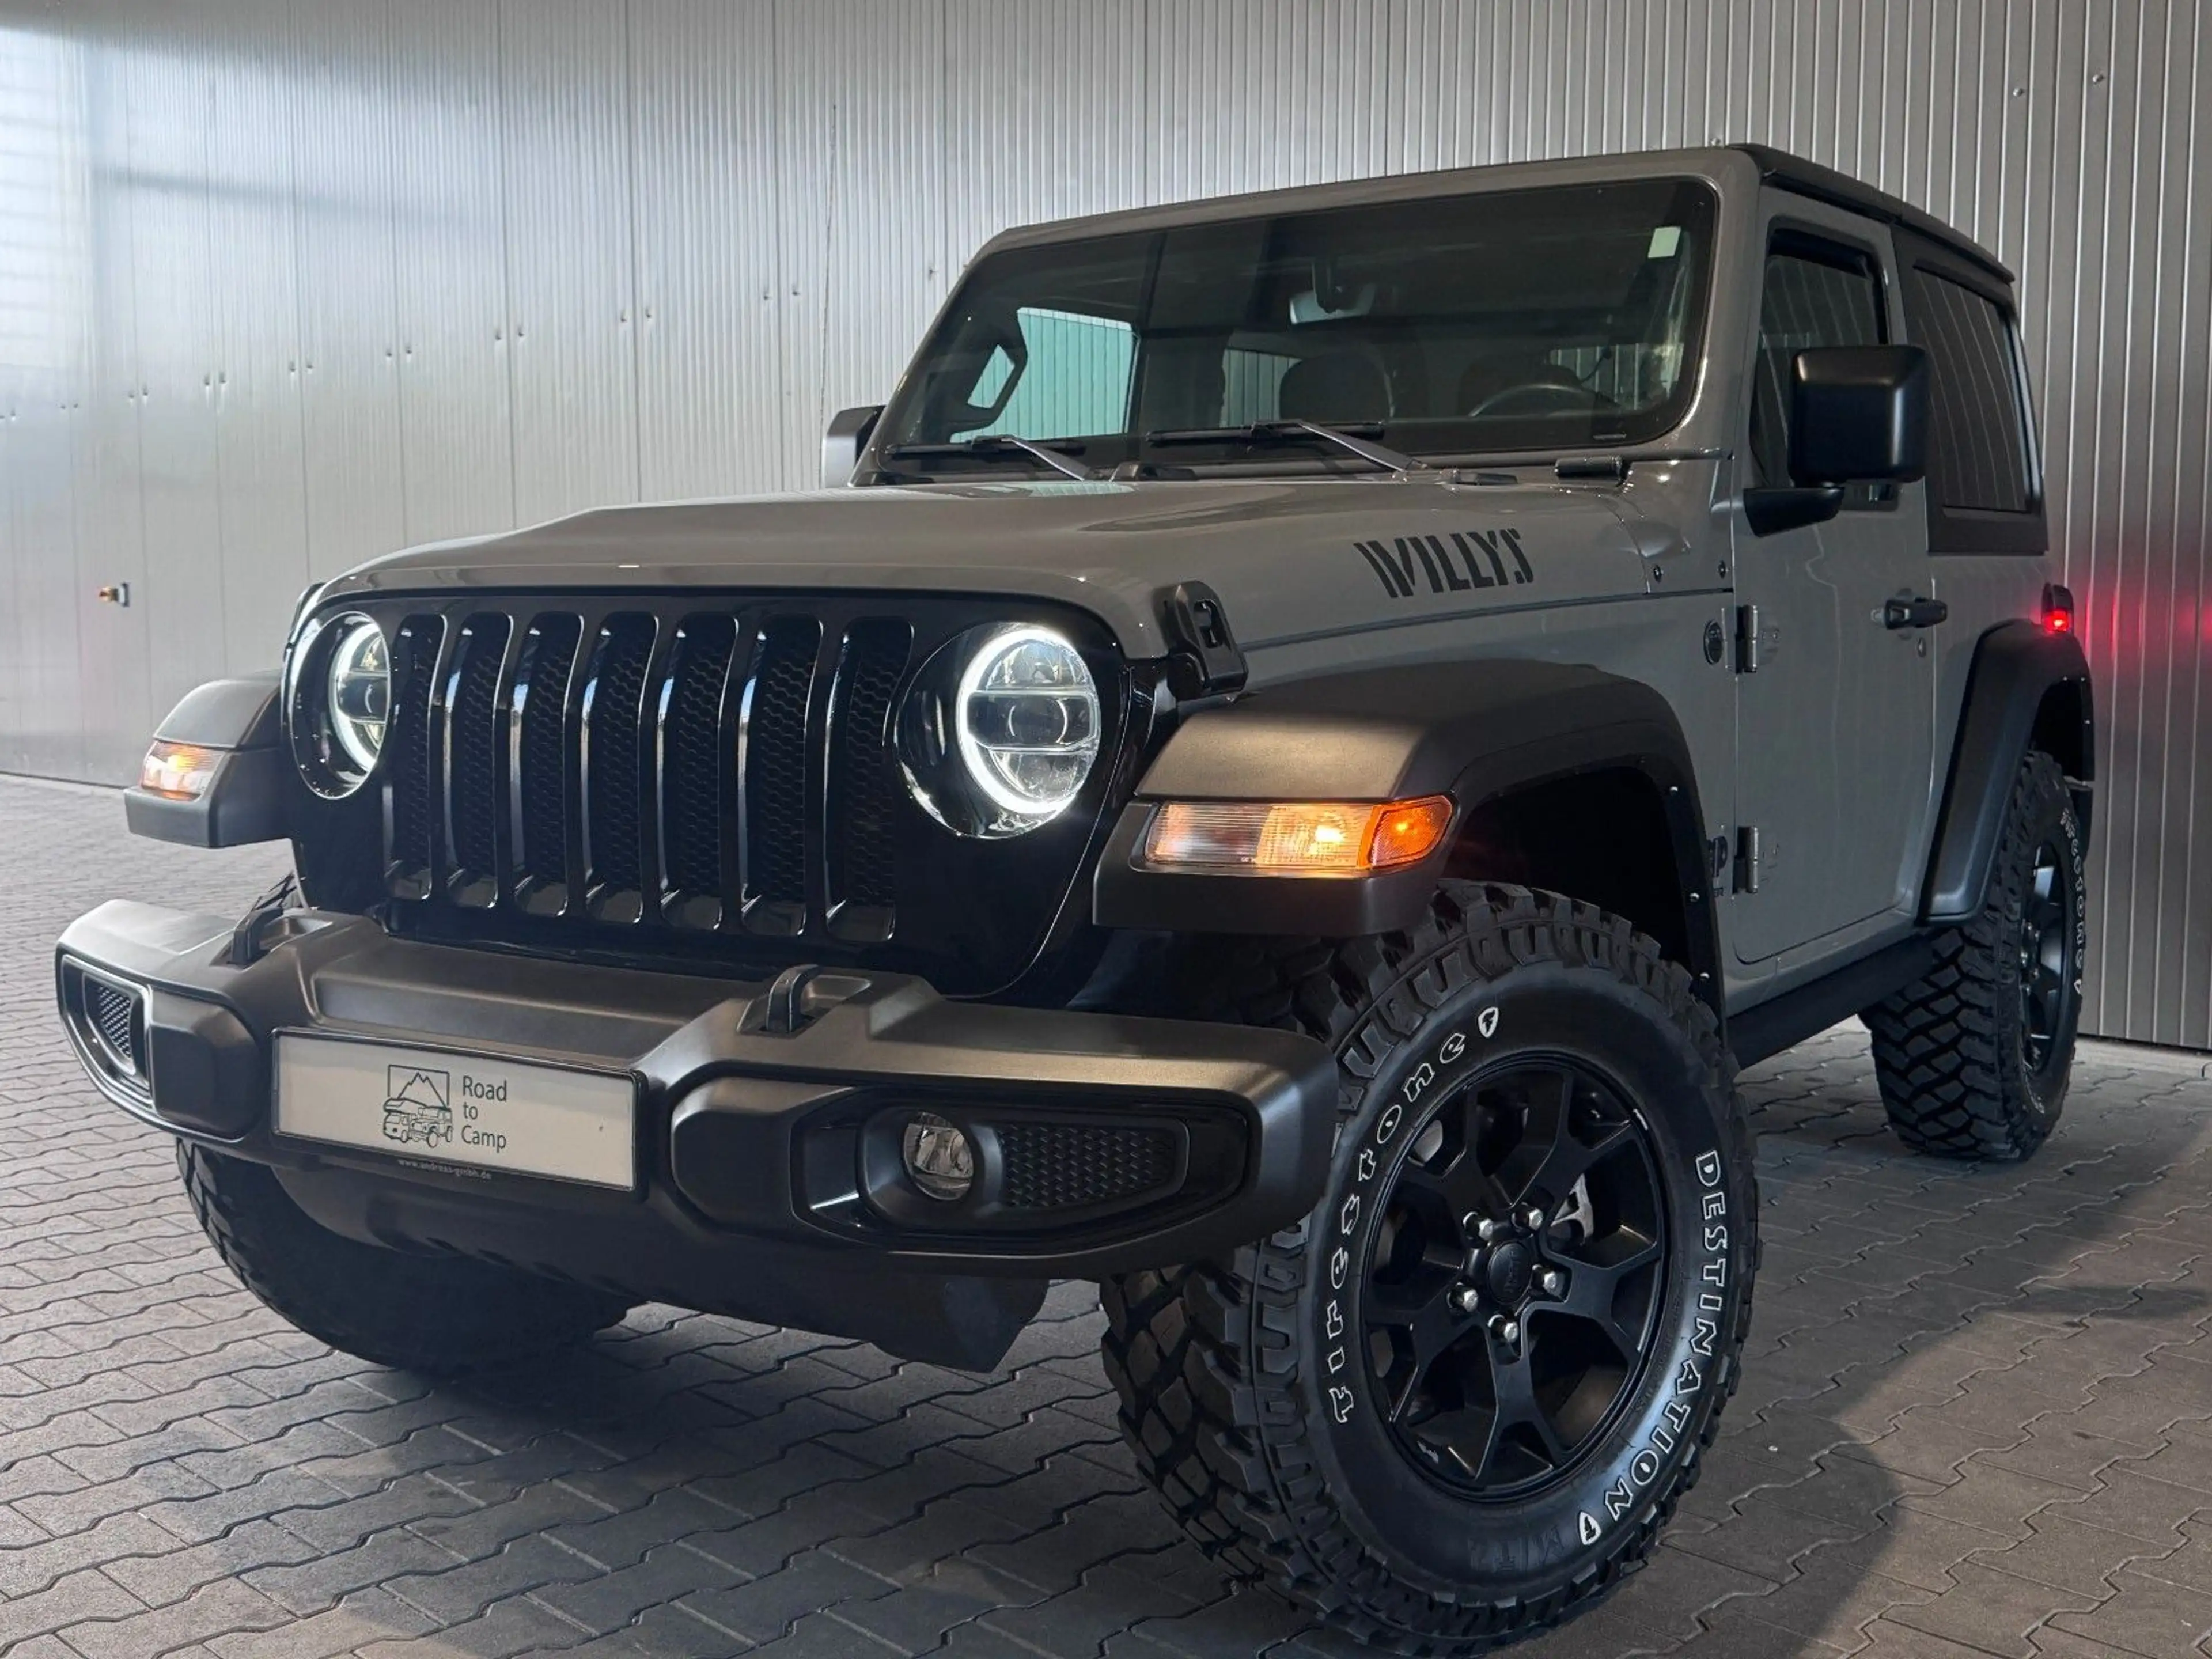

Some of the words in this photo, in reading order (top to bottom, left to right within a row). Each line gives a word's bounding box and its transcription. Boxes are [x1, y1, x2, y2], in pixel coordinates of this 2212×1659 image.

[1353, 528, 1533, 598] WILLYS
[463, 1075, 507, 1102] Road
[463, 1101, 478, 1120] to
[461, 1124, 507, 1153] Camp
[1326, 1031, 1466, 1423] Firestone
[1604, 1150, 1728, 1521] DESTINATION
